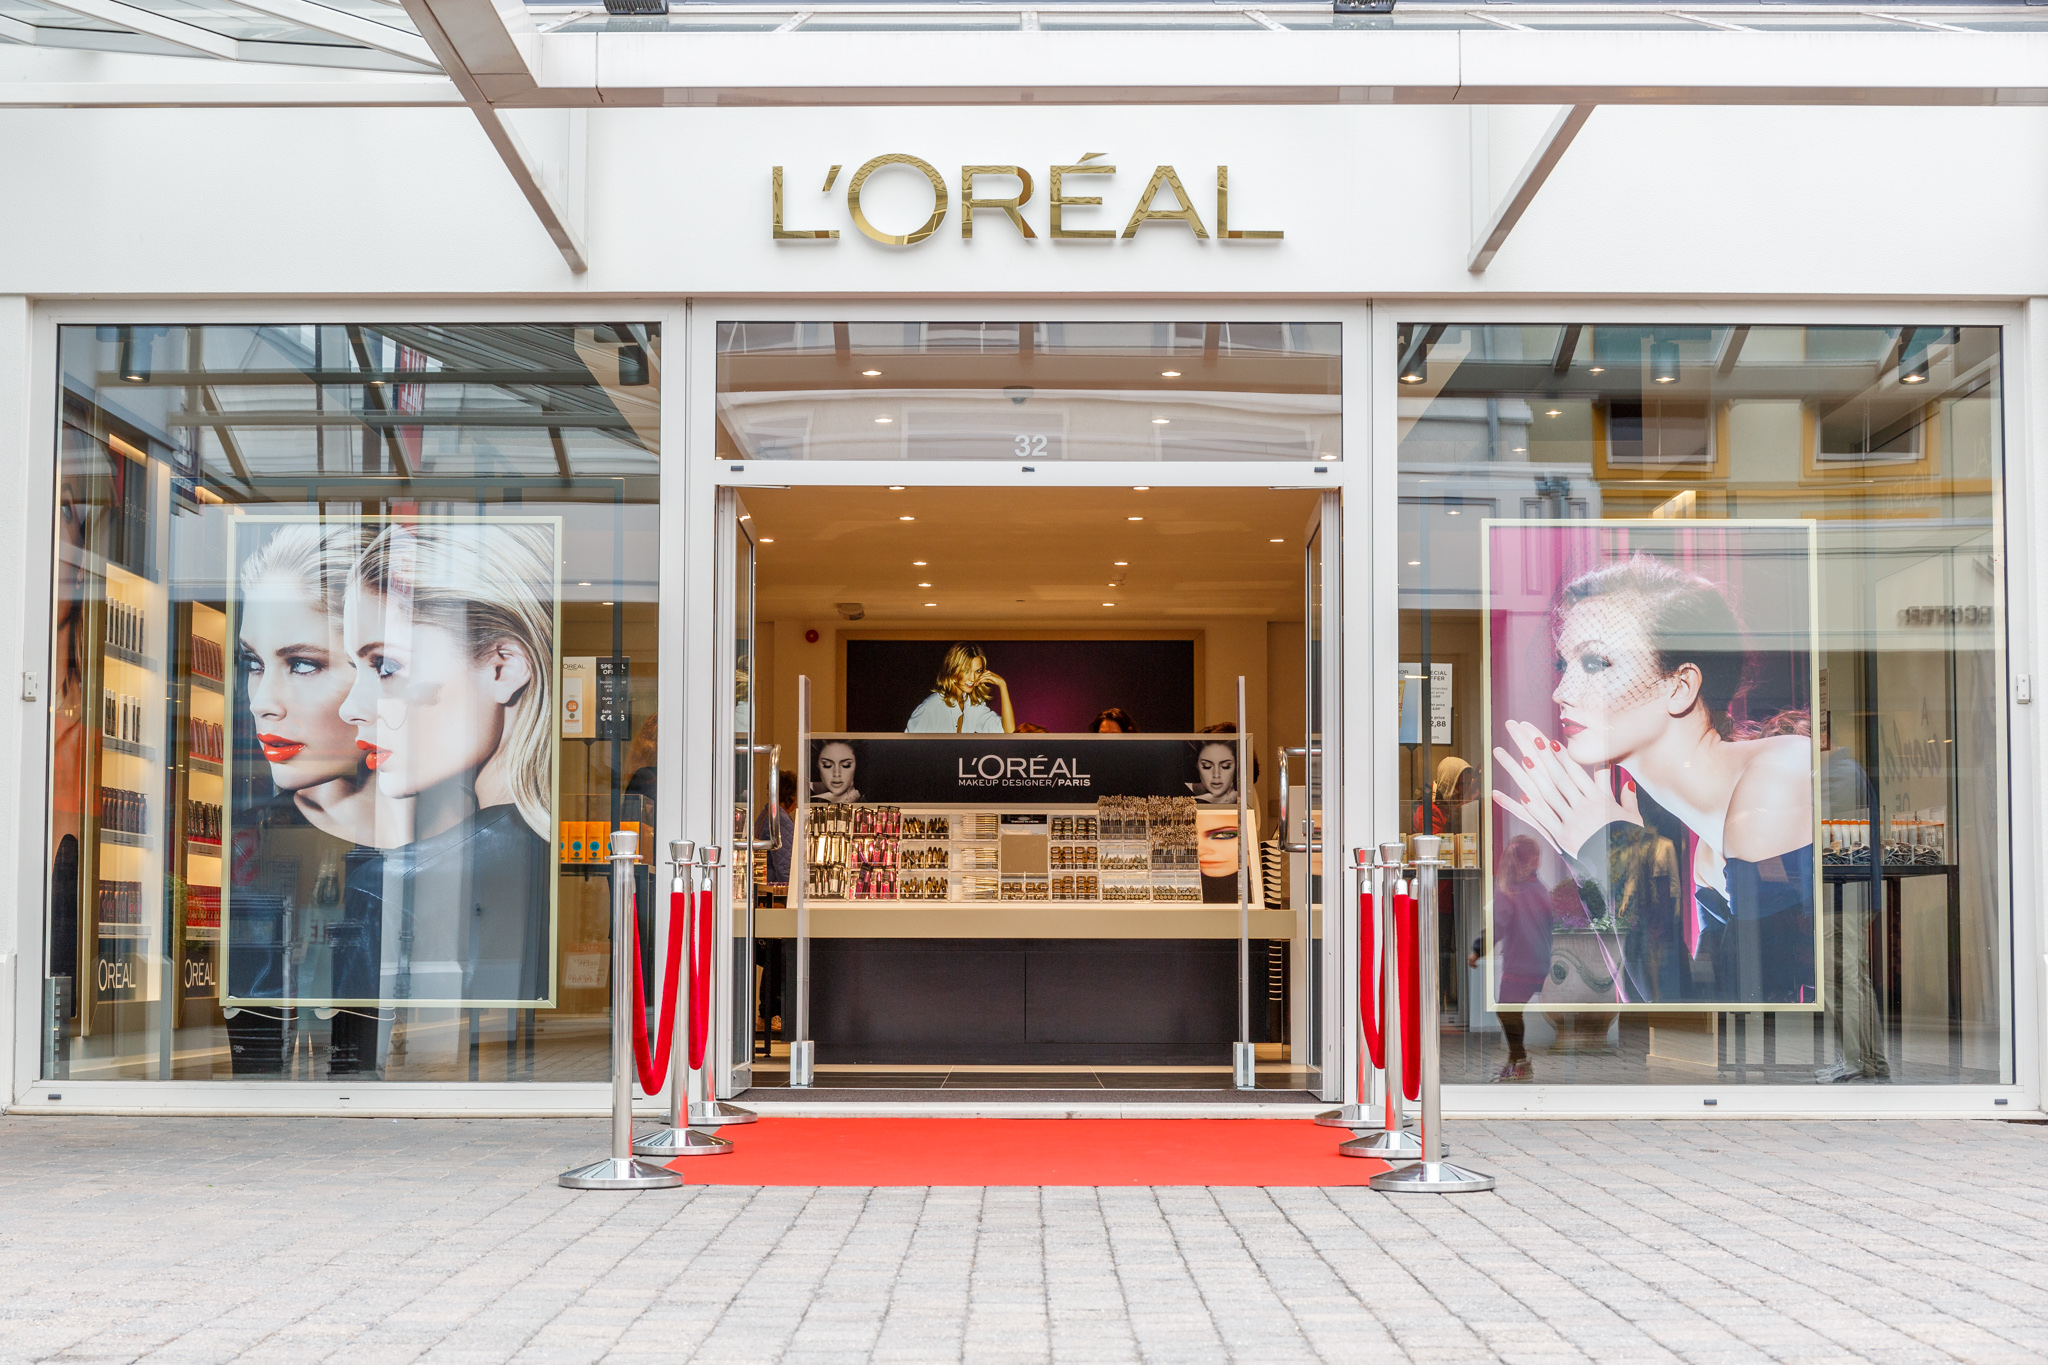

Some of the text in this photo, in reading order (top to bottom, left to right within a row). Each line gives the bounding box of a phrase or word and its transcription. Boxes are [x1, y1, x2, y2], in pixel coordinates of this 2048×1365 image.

[772, 152, 1285, 245] L'ORÉAL
[1014, 434, 1048, 457] 32
[1431, 720, 1447, 728] 2,88
[958, 754, 1091, 780] L'ORÉAL
[958, 777, 1091, 788] MAKEUP DESIGNER/PARIS
[98, 958, 136, 992] ORÉAL
[185, 958, 216, 989] ORÉAL
